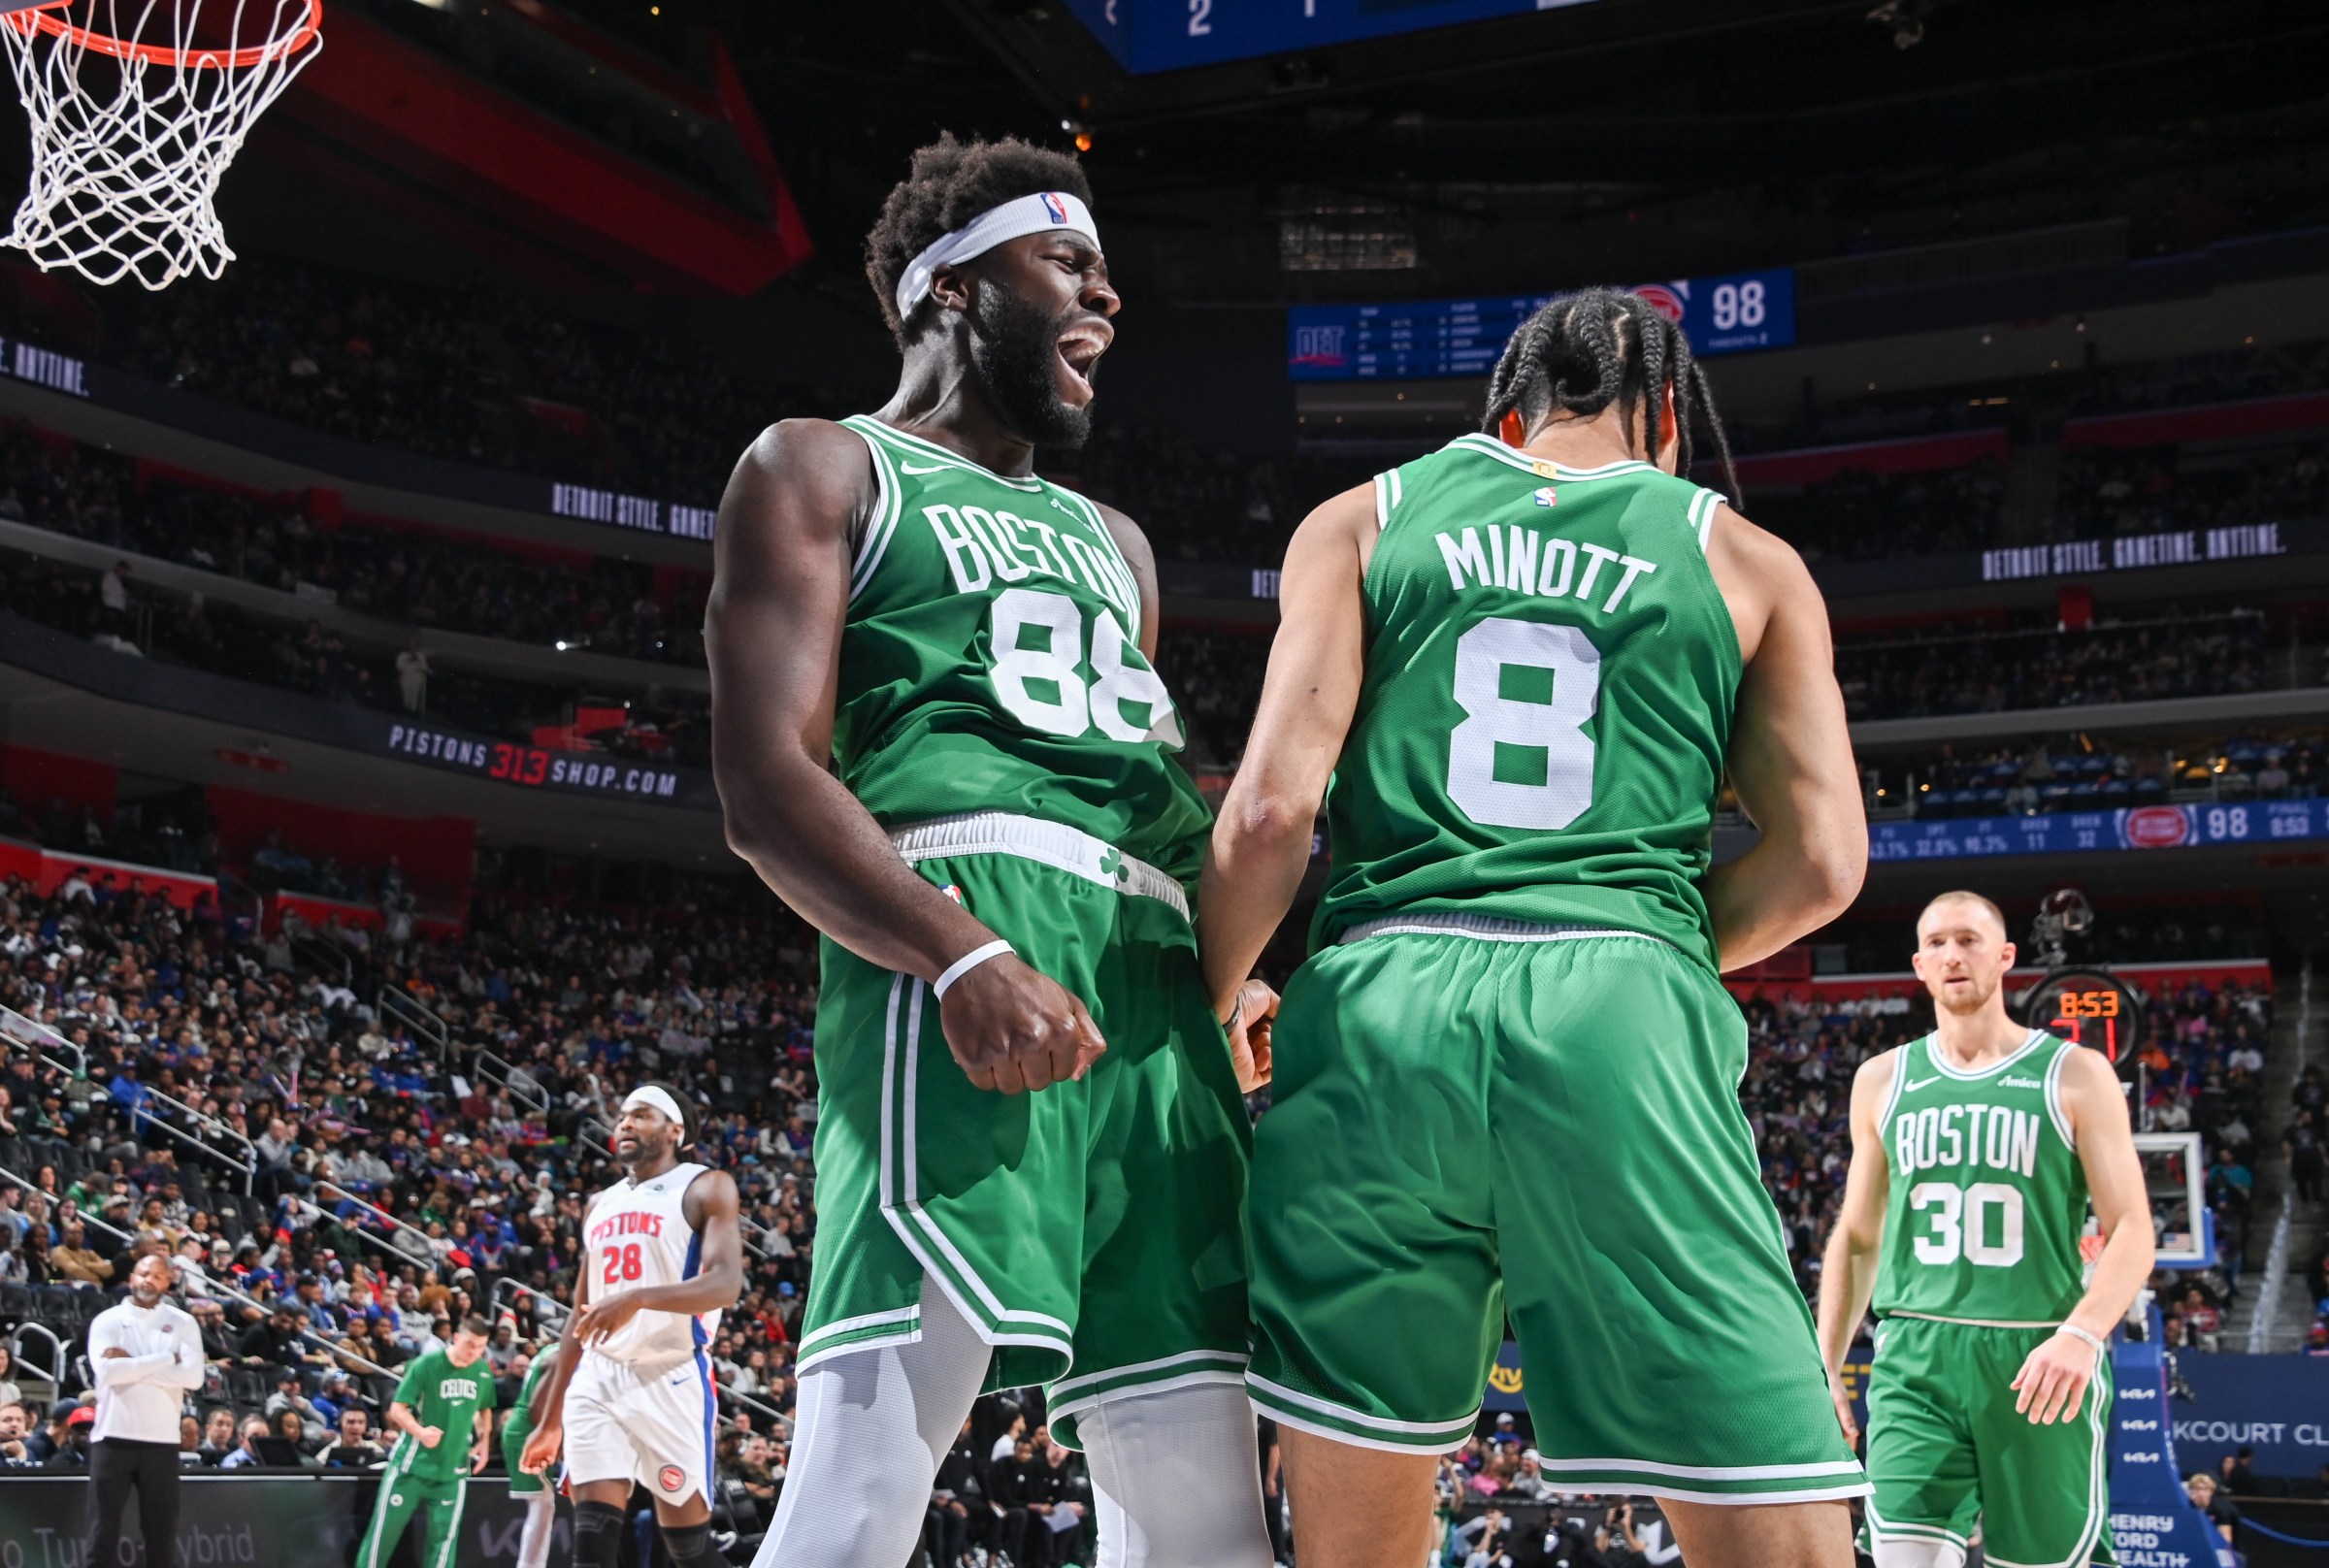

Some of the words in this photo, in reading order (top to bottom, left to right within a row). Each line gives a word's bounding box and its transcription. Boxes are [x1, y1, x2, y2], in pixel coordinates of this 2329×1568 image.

[1713, 280, 1765, 330] 98
[922, 505, 1139, 637] BOSTON
[1434, 525, 1657, 613] MINOTT
[990, 589, 1186, 753] 88
[1447, 617, 1600, 830] 8
[388, 726, 486, 768] PISTONS
[490, 743, 550, 785] 313
[551, 760, 676, 797] SHOP.COM
[2208, 806, 2248, 839] 98
[2060, 991, 2119, 1018] 8:53
[1997, 1074, 2041, 1090] Amica
[1895, 1103, 2040, 1178] BOSTON
[590, 1211, 664, 1249] PISTONS
[1910, 1183, 2023, 1267] 30
[603, 1243, 641, 1284] 28
[440, 1379, 477, 1400] CELTICS
[2173, 1421, 2286, 1444] KCOURT
[2293, 1424, 2329, 1447] CL
[2112, 1531, 2159, 1550] ORD
